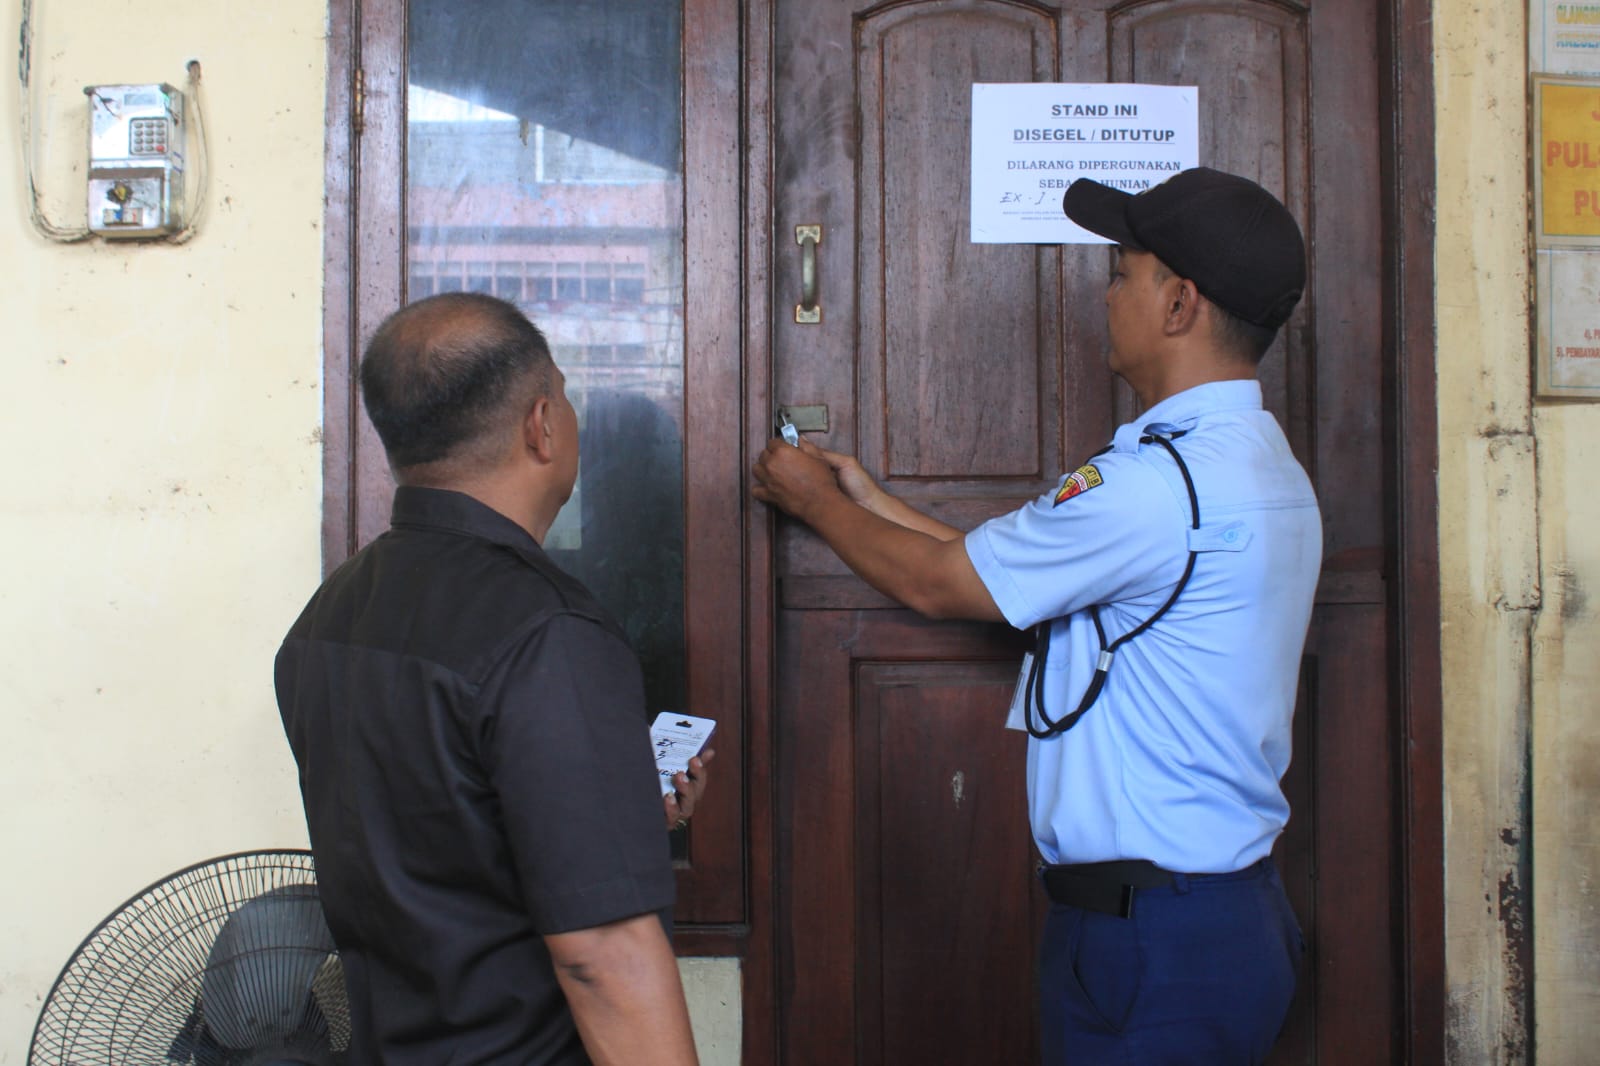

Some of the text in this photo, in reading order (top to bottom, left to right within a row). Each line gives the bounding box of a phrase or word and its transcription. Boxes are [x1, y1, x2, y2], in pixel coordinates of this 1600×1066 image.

[1051, 105, 1138, 117] STAND INI
[1013, 129, 1086, 142] DISEGEL
[1101, 129, 1175, 142] DITUTUP
[1546, 141, 1600, 168] PUL
[1007, 160, 1181, 171] DILARANG DIPERGUNAKAN
